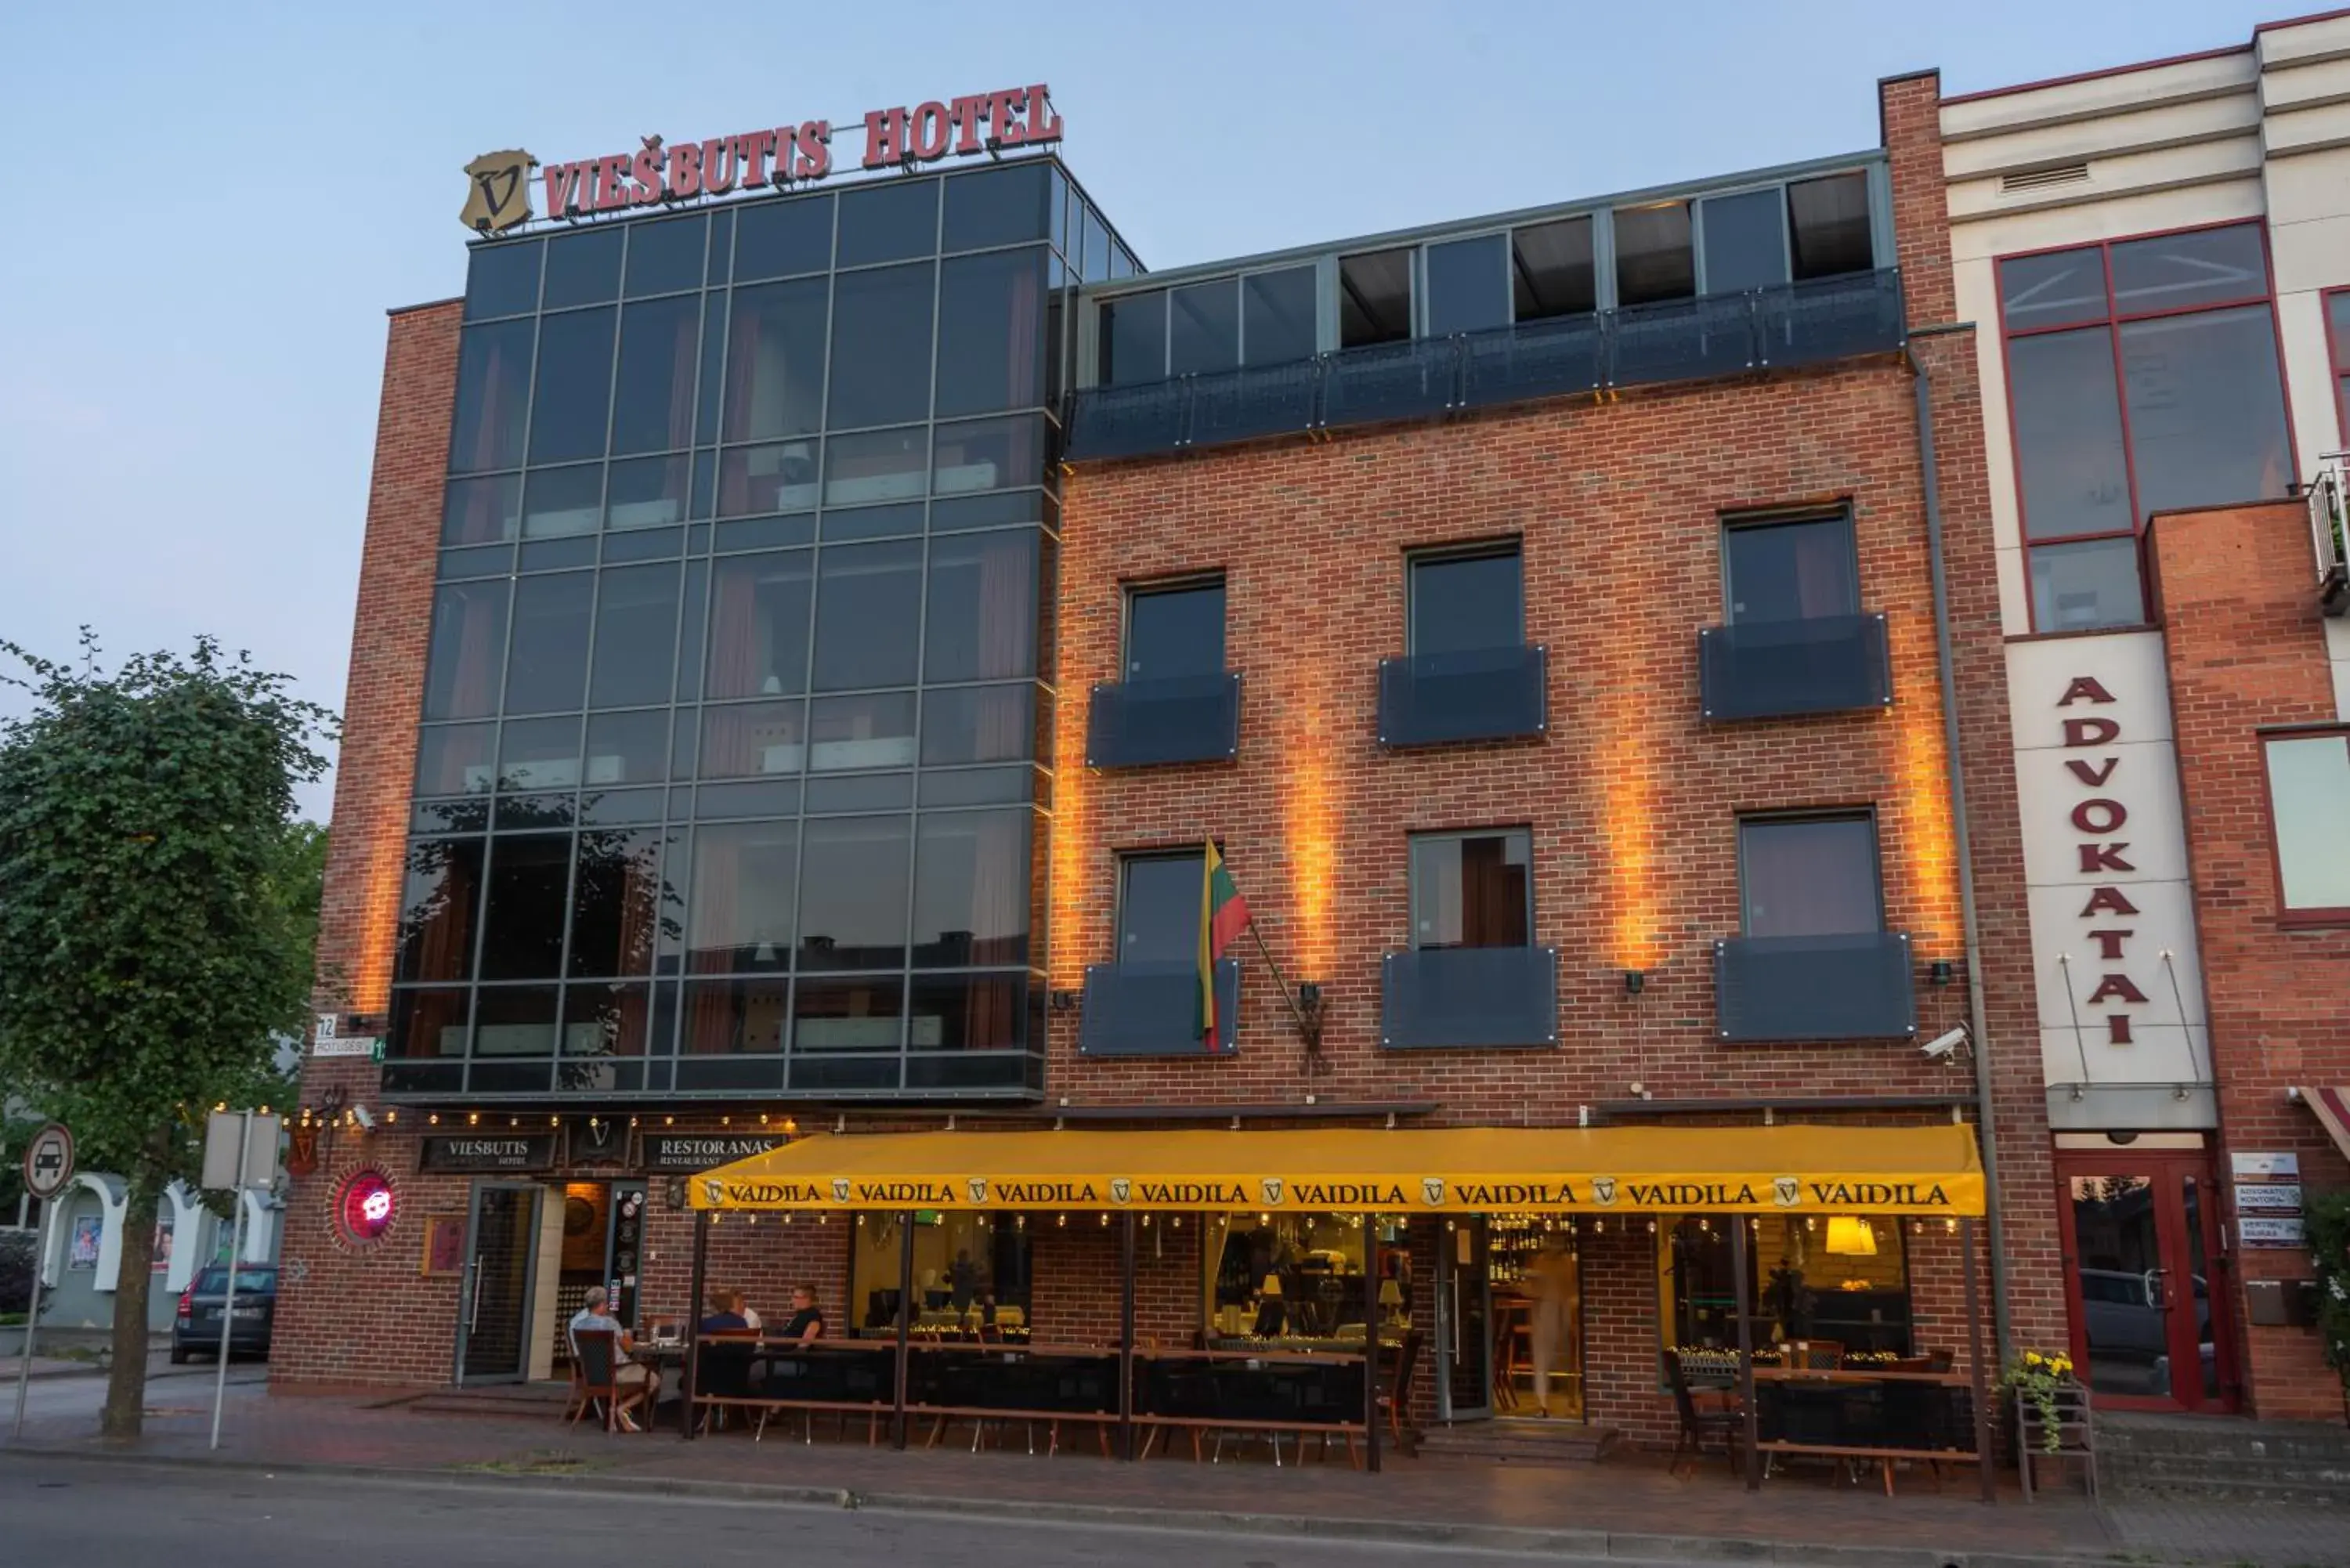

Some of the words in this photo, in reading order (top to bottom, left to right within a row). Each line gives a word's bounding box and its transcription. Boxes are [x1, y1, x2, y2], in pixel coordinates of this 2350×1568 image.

[542, 121, 830, 221] VIEŠBUTIS
[862, 84, 1061, 169] HOTEL
[2056, 676, 2149, 1044] ADVOKATAI
[660, 1140, 772, 1154] RESTORANAS
[728, 1183, 820, 1202] VAIDILA
[859, 1183, 956, 1203] VAIDILA
[996, 1183, 1097, 1202] VAIDILA
[1139, 1183, 1248, 1203] VAIDILA
[1292, 1184, 1407, 1205] VAIDILA
[1455, 1184, 1578, 1205] VAIDILA
[1628, 1183, 1758, 1205] VAIDILA
[1811, 1183, 1950, 1205] VAIDILA
